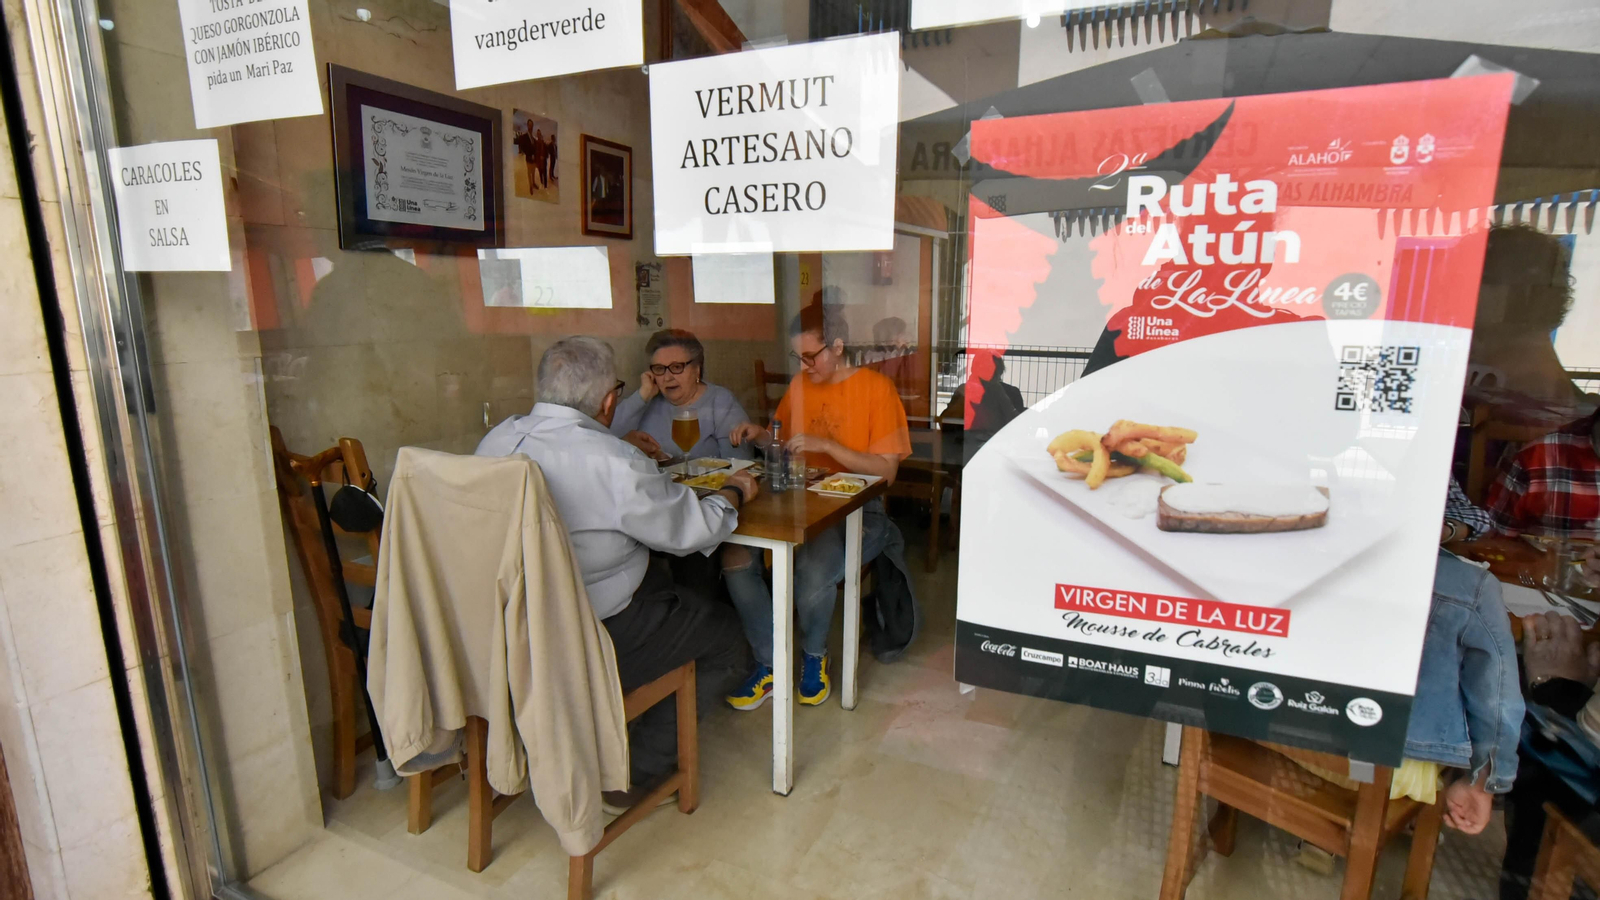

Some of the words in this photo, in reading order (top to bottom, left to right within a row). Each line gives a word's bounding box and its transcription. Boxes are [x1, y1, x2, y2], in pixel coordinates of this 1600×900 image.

[190, 22, 222, 45] QUESO
[224, 6, 300, 34] GORGONZOLA
[474, 7, 606, 51] vangderverde
[194, 47, 216, 65] CON
[216, 38, 251, 64] JAMÓN
[253, 31, 301, 54] IBÉRICO
[207, 70, 228, 89] pida
[229, 70, 242, 82] un
[246, 62, 271, 79] Mari
[272, 60, 293, 75] Paz
[695, 75, 835, 119] VERMUT
[680, 126, 853, 169] ARTESANO
[121, 160, 203, 187] CARACOLES
[155, 199, 169, 216] EN
[704, 180, 827, 215] CASERO
[1125, 173, 1278, 219] Ruta
[149, 227, 190, 247] SALSA
[1125, 221, 1151, 234] del
[1141, 220, 1301, 266] Atún
[1138, 270, 1163, 290] de
[1151, 268, 1216, 318] La
[1206, 268, 1323, 318] Línea
[1333, 282, 1369, 301] 4€
[1146, 326, 1180, 337] Línea
[1147, 316, 1173, 326] Una
[1060, 586, 1147, 615] VIRGEN
[1156, 599, 1188, 620] DE
[1196, 604, 1226, 626] LA
[1234, 610, 1285, 634] LUZ
[1061, 611, 1140, 639] Mousse
[1142, 627, 1169, 643] de
[1176, 629, 1276, 658] Cabrales
[1023, 650, 1062, 664] Cruzcampo
[1079, 657, 1108, 671] BOAT
[1108, 662, 1139, 676] HAUS
[1178, 677, 1206, 691] Pinna
